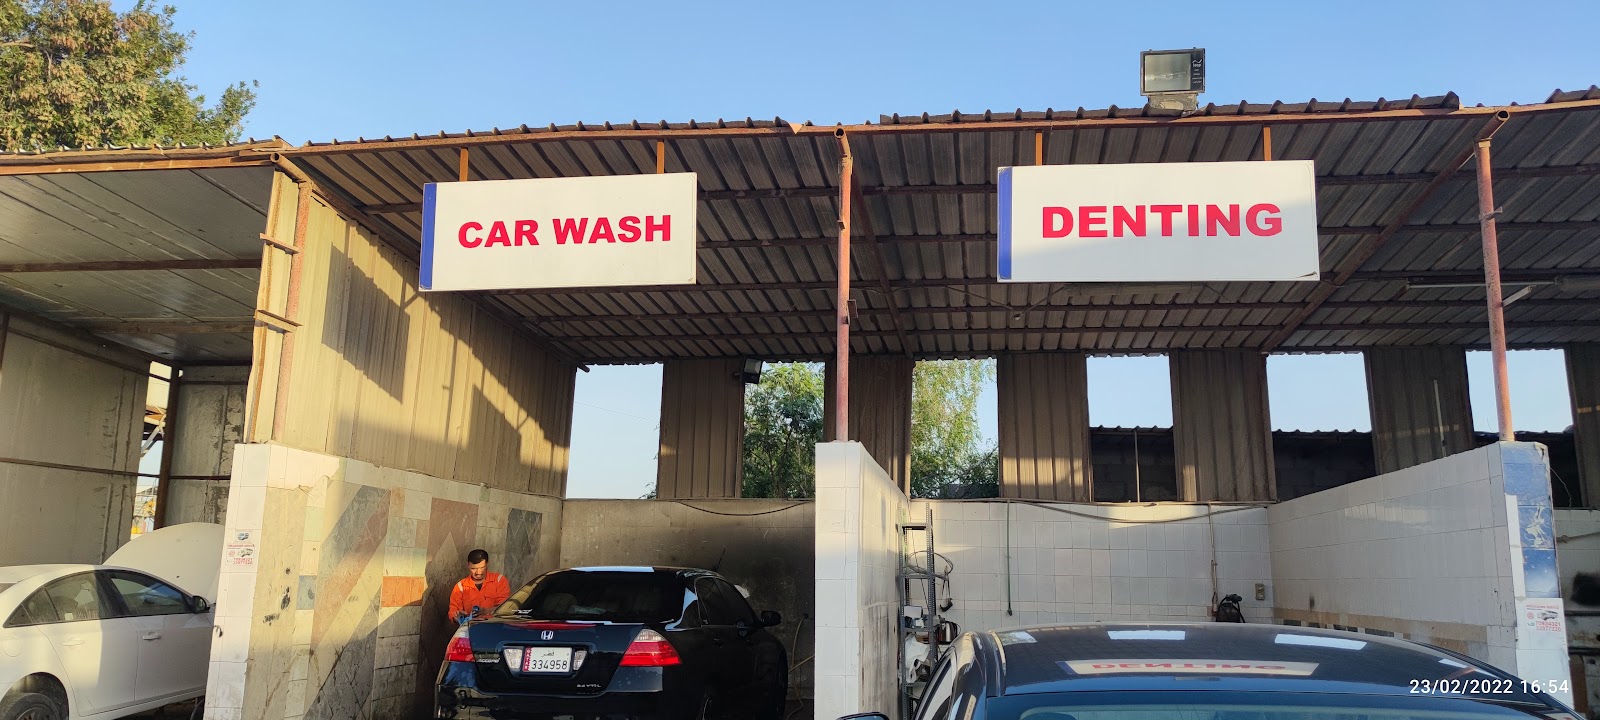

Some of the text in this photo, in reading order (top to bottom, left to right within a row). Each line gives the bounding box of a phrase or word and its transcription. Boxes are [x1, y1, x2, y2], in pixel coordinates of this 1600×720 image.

[458, 215, 671, 248] CAR WASH
[1043, 203, 1282, 238] DENTING
[532, 660, 568, 670] 334958
